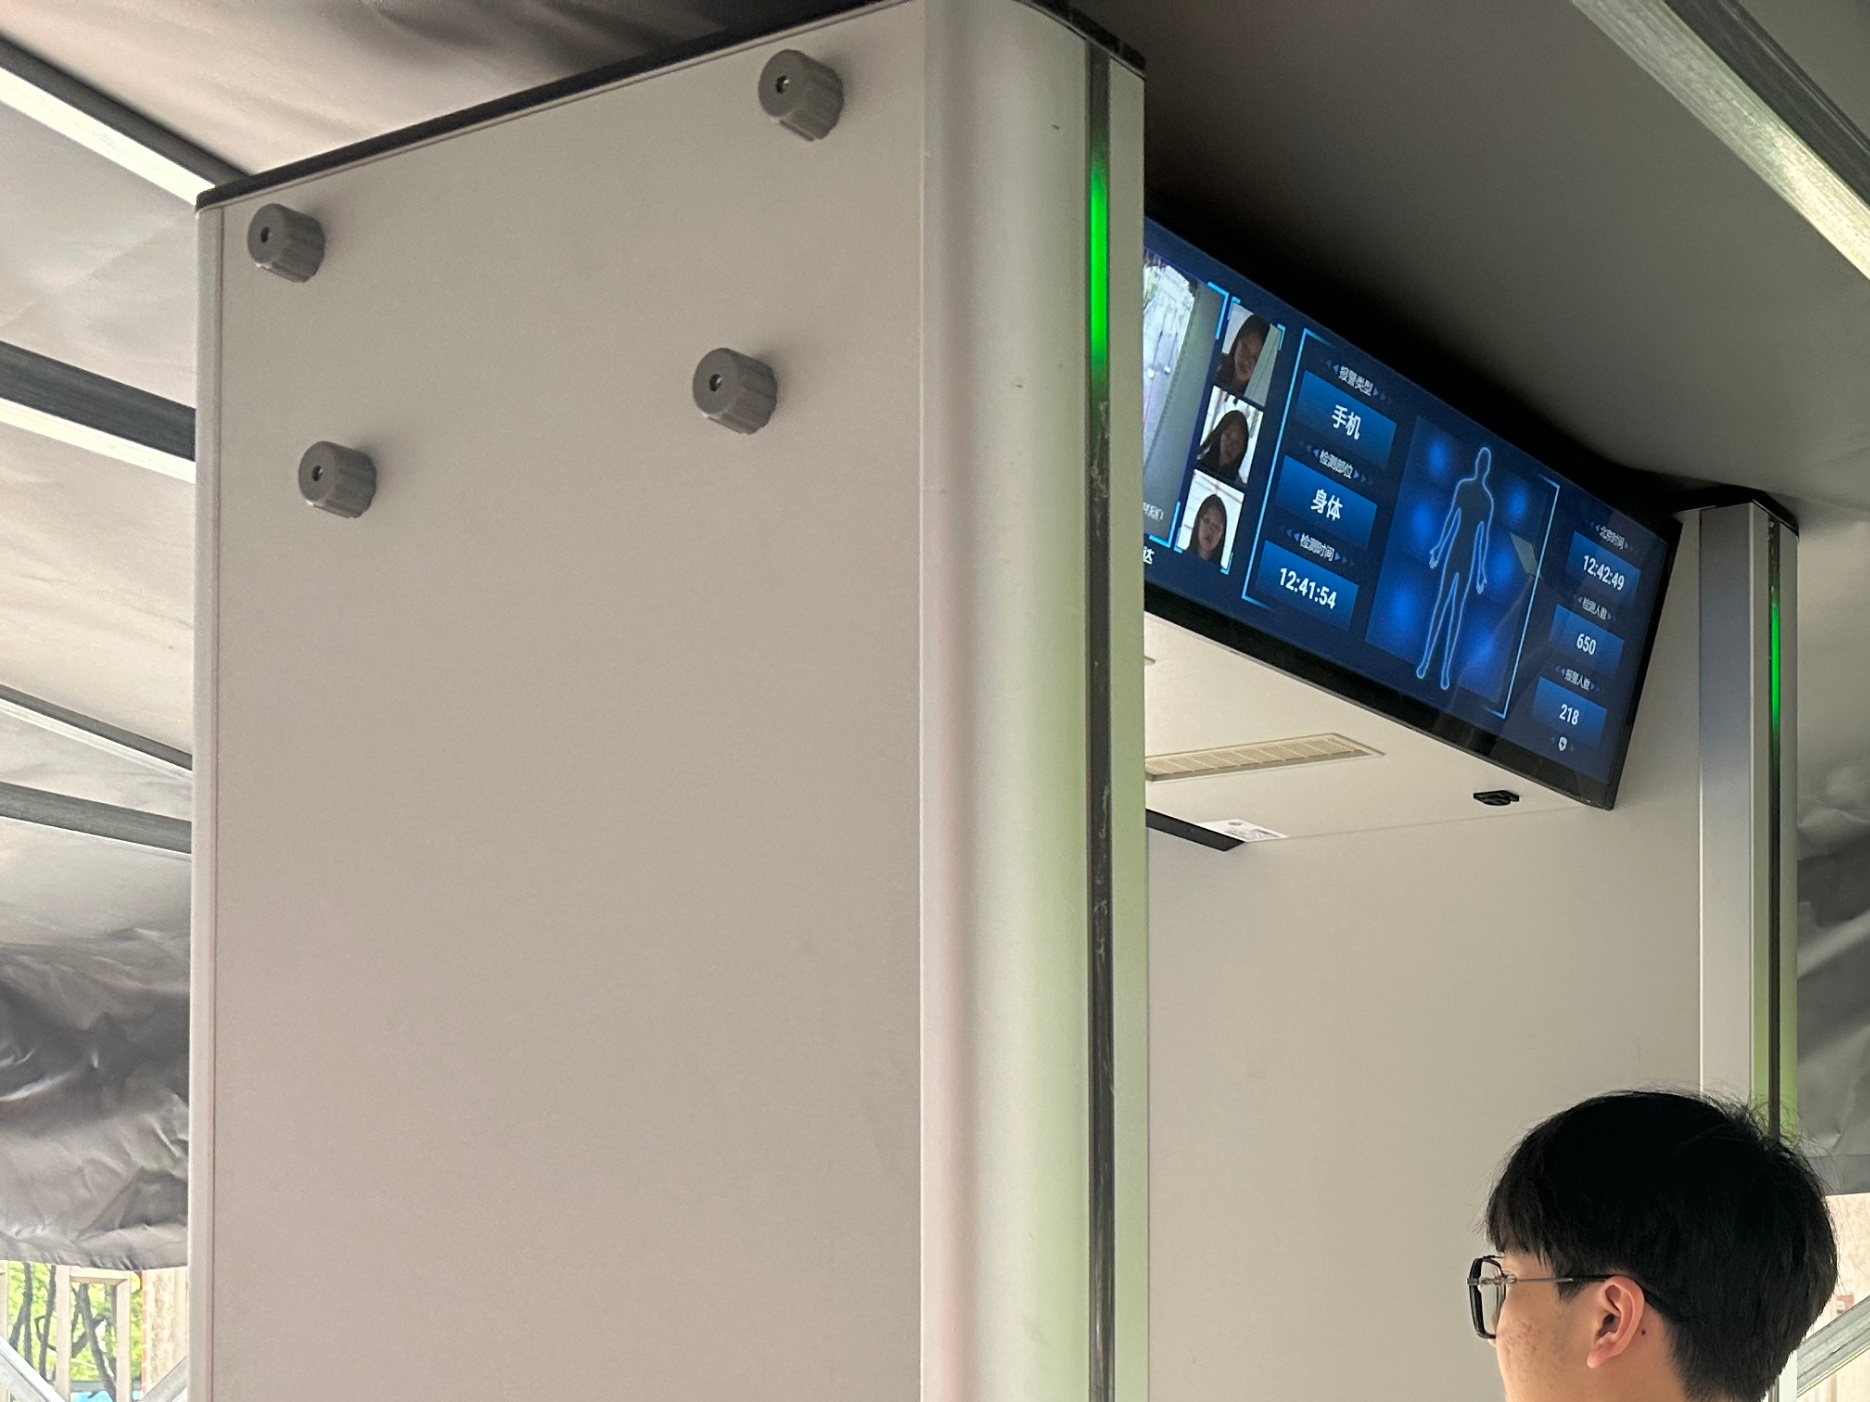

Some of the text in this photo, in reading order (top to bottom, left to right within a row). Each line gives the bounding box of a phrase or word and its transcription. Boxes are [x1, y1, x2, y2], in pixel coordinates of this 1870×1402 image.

[1331, 404, 1362, 440] 手机
[1310, 488, 1343, 521] 身体
[1279, 567, 1337, 610] 12:41:54
[1583, 555, 1625, 591] 12:42:49
[1576, 633, 1597, 655] 650
[1559, 703, 1580, 726] 218
